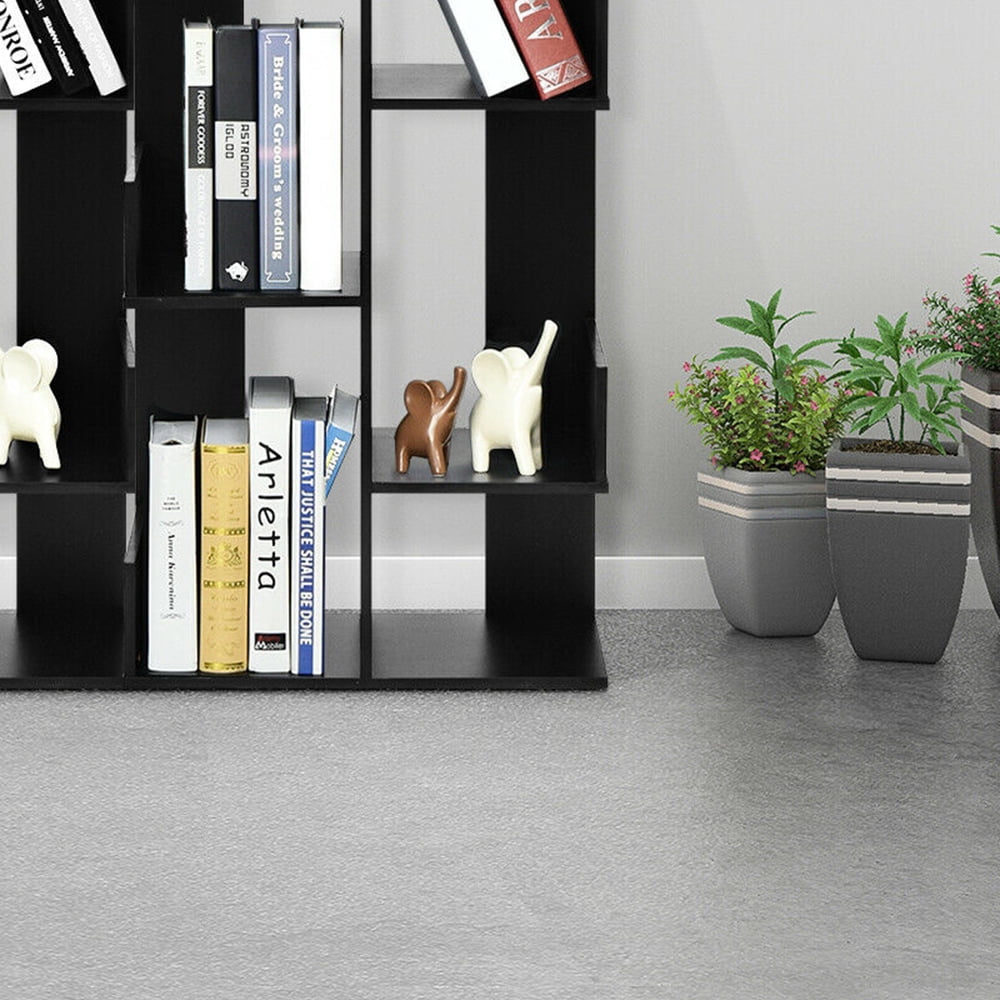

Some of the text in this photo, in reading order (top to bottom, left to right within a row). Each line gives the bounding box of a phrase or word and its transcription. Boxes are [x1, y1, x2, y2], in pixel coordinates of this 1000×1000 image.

[197, 90, 205, 163] FOREVER GODDESS
[225, 123, 233, 158] IGLOO
[240, 124, 249, 196] ASTRONOMY
[271, 56, 284, 259] Bride & Groom's wedding
[167, 532, 175, 558] Anna
[257, 441, 283, 590] Arletta
[299, 450, 313, 645] THAT JUSTICE SHALL BE DONE
